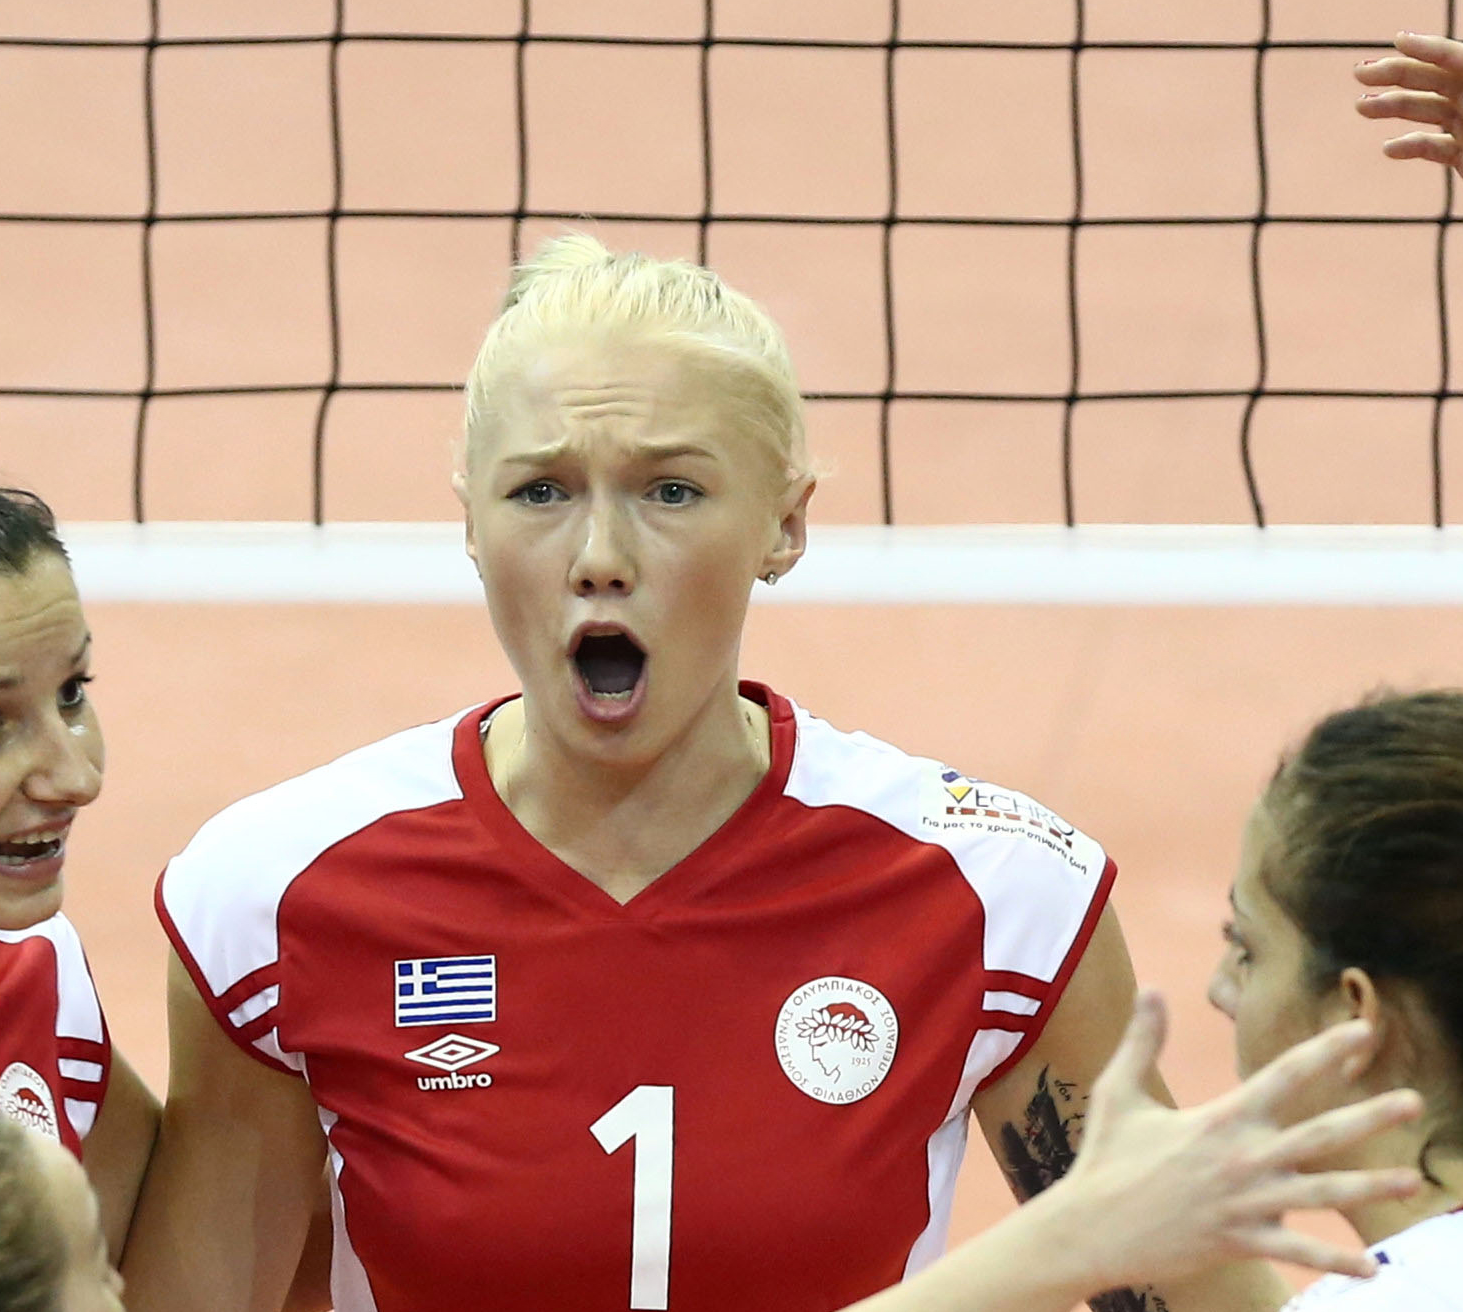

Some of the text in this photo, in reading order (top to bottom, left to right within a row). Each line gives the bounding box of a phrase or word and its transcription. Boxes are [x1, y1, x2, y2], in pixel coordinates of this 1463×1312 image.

[793, 980, 881, 1006] ΟΛΥΜΠΙΑΚΟΣ
[417, 1072, 493, 1091] umbro
[589, 1085, 674, 1311] 1
